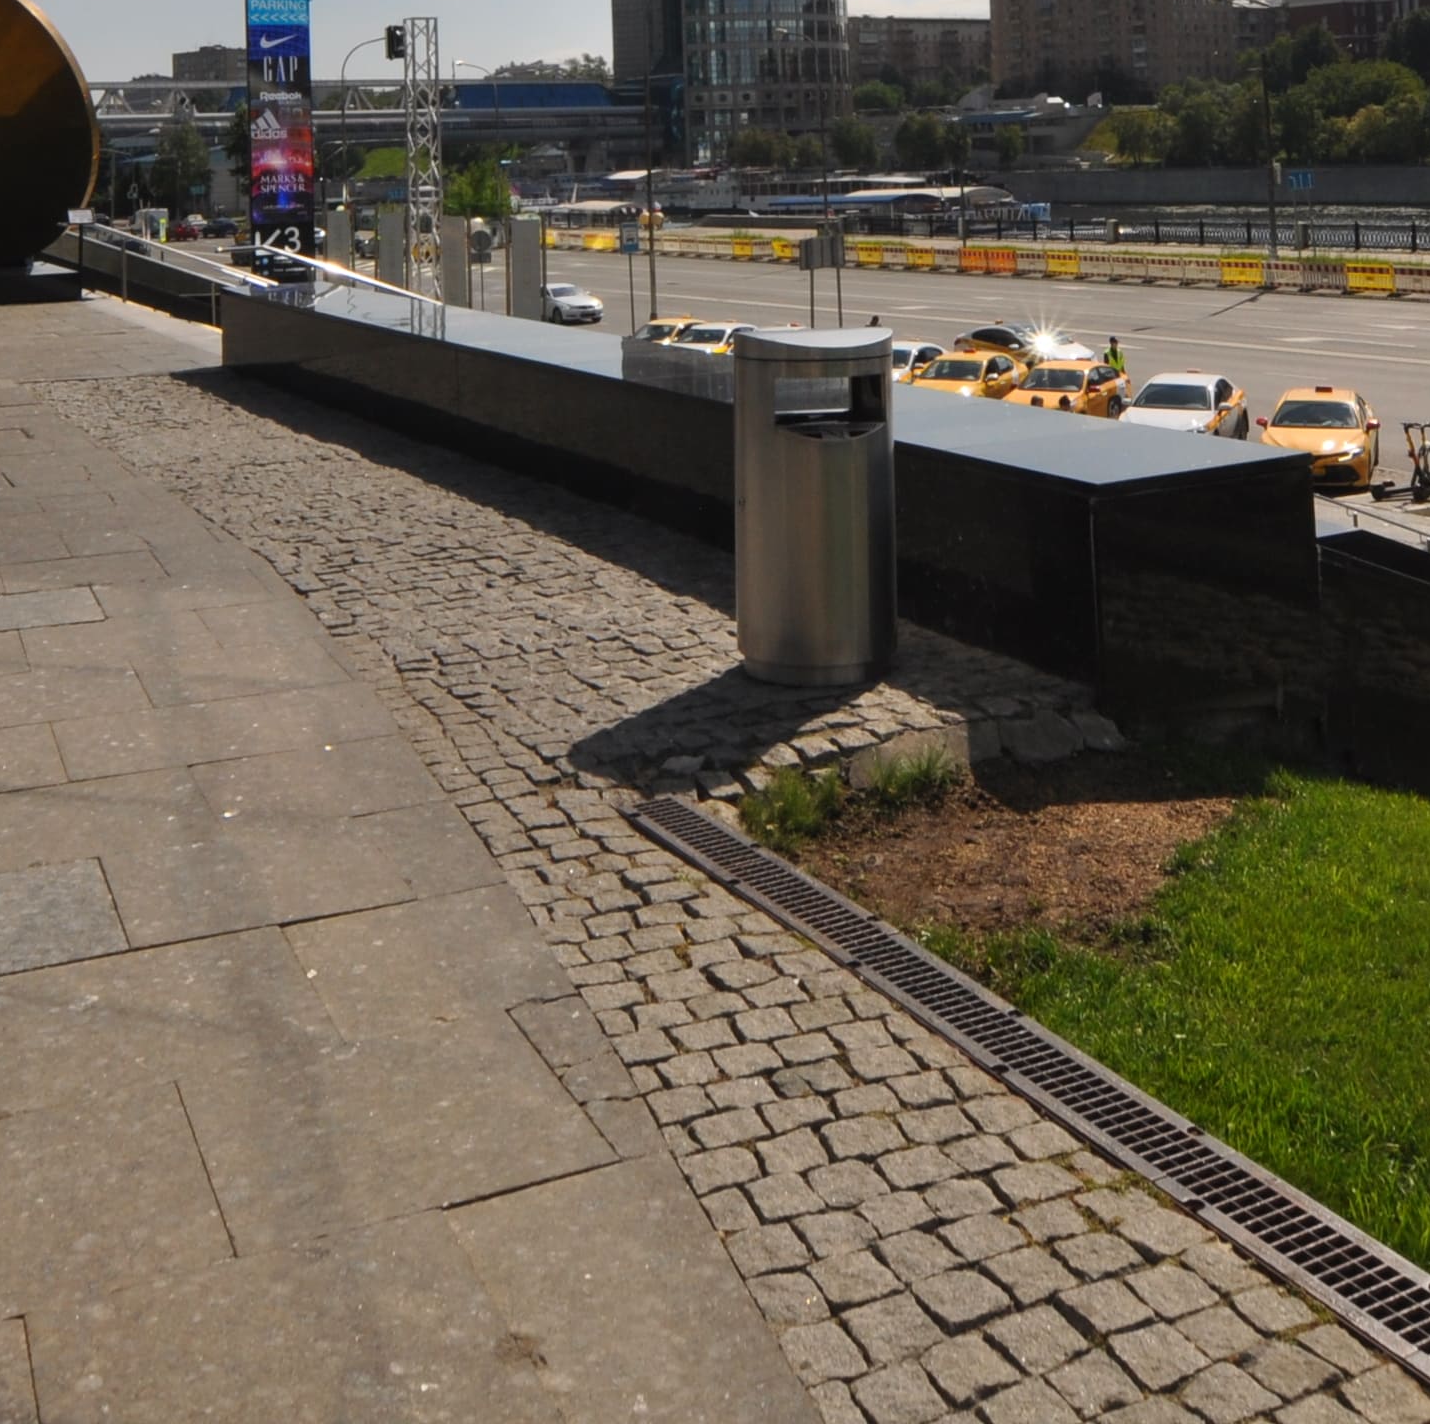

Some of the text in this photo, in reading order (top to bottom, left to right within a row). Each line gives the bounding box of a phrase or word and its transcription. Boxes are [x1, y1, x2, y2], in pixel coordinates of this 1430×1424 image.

[250, 0, 308, 11] PARKING
[263, 55, 298, 83] GAP
[259, 91, 302, 102] Reebok
[260, 173, 305, 184] MARKS &
[260, 182, 306, 194] SPENCER
